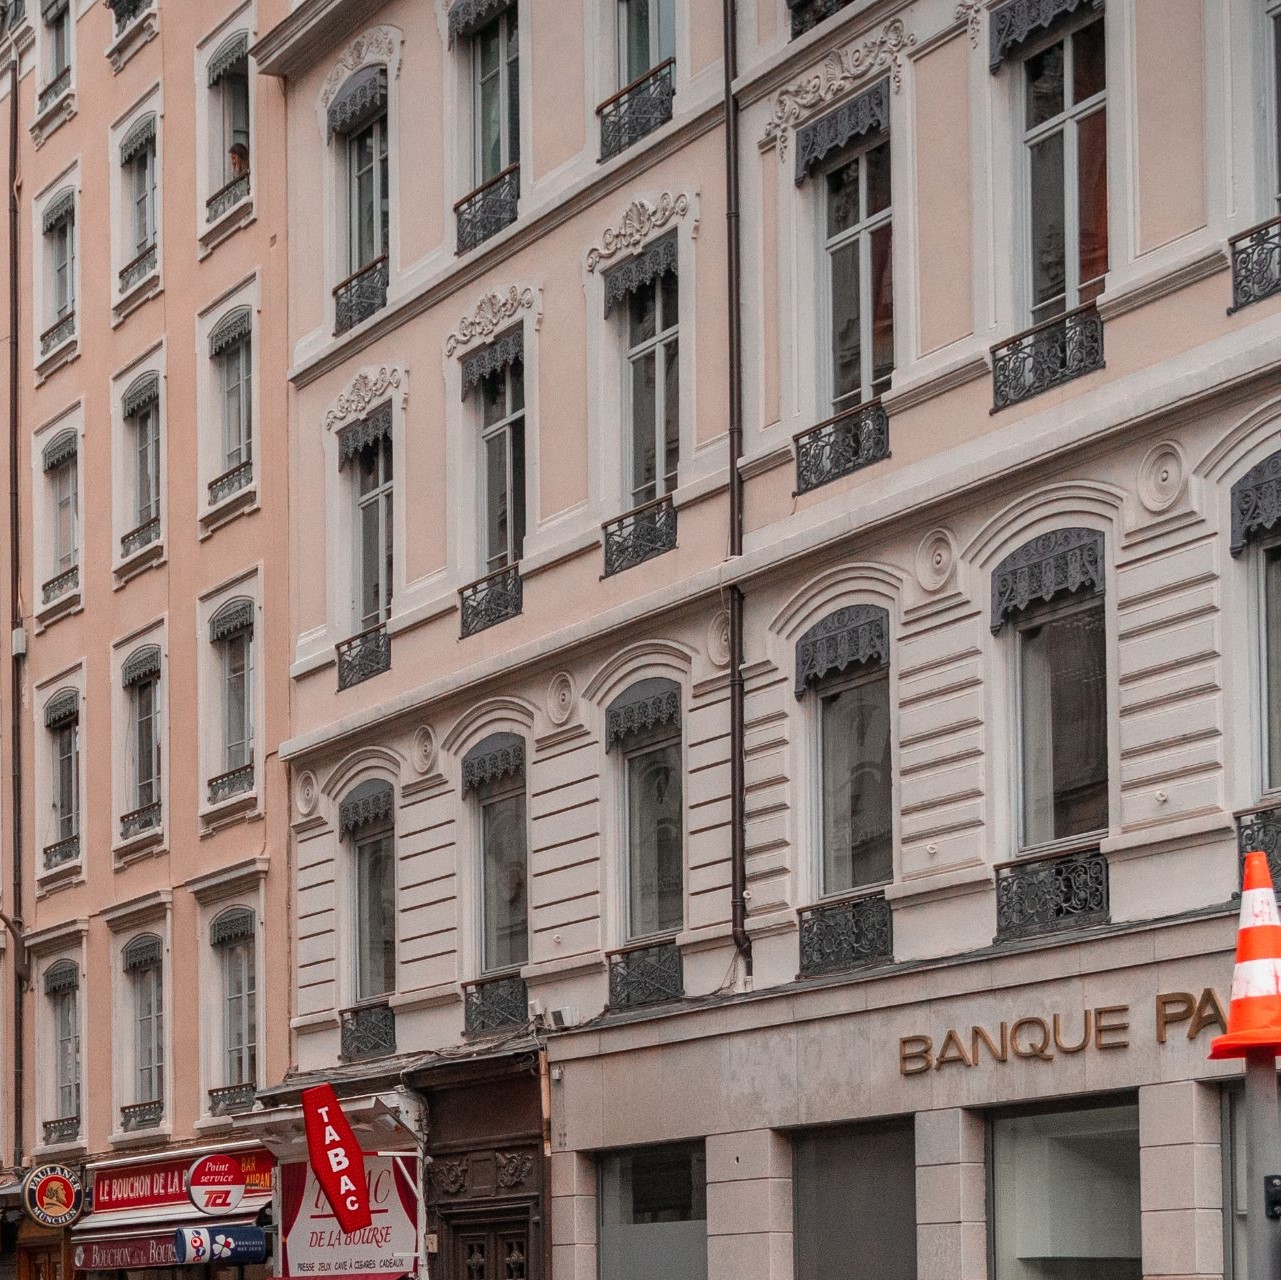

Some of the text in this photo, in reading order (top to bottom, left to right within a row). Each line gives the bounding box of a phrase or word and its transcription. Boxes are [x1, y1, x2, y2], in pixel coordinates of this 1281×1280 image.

[899, 1004, 1130, 1077] BANQUE
[205, 1162, 229, 1172] Point
[241, 1157, 256, 1173] BAR
[317, 1106, 359, 1211] TABAC
[29, 1166, 81, 1191] PAULANER
[99, 1181, 110, 1203] LE
[111, 1176, 151, 1200] BOUCHON
[153, 1174, 165, 1196] DE
[167, 1171, 180, 1193] LA
[200, 1173, 233, 1183] service
[203, 1190, 232, 1208] TCL
[309, 1225, 393, 1249] DE LA BOURSE
[92, 1245, 131, 1267] BOUCHON
[297, 1262, 315, 1272] PRESSE
[317, 1261, 332, 1272] JEUX
[334, 1261, 348, 1271] CAVE
[354, 1259, 376, 1270] CIGARES
[379, 1259, 404, 1268] CADEAUX
